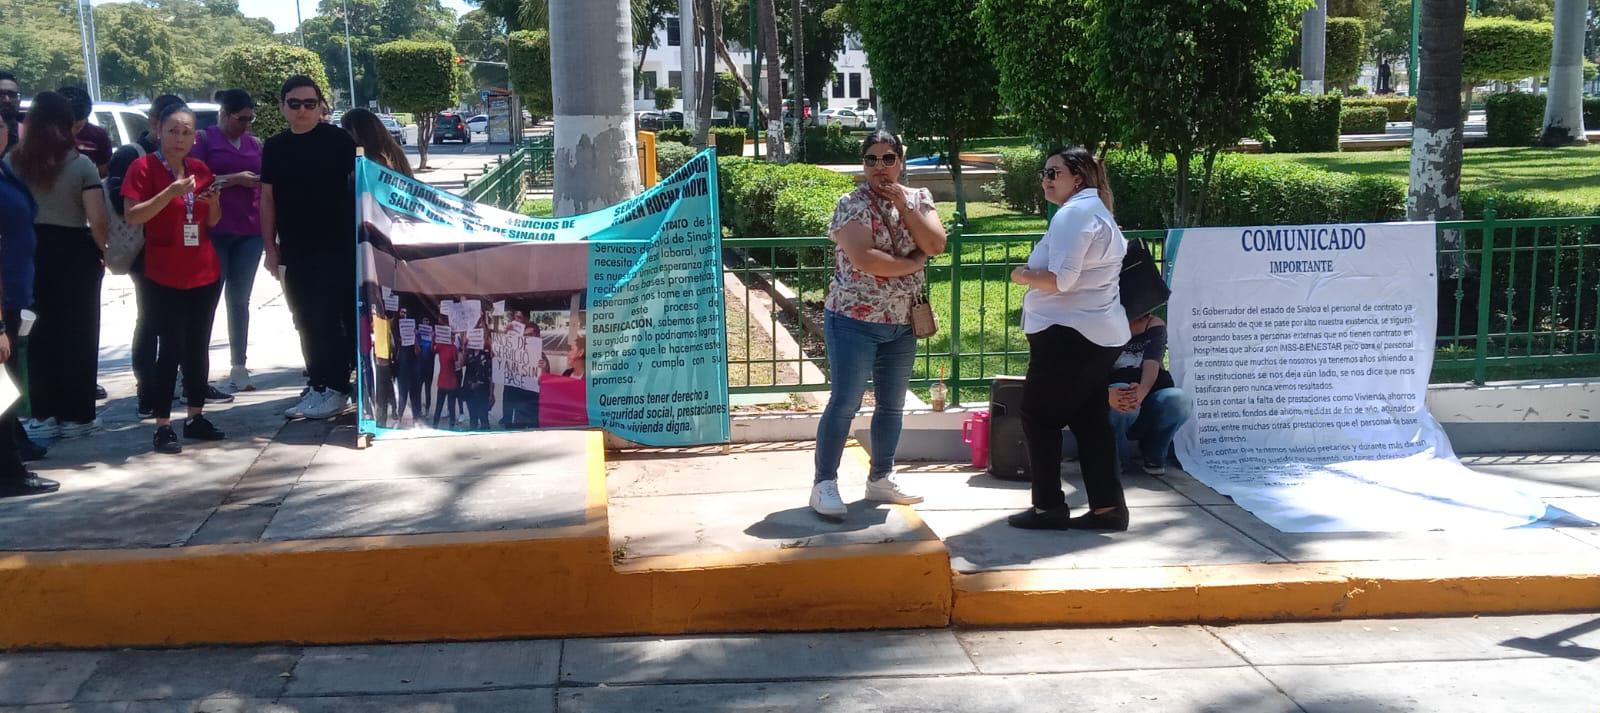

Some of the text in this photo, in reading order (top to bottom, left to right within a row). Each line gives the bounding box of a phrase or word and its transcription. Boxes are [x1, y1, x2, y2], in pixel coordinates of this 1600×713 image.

[645, 178, 708, 215] ROCHA MOYA
[562, 219, 575, 229] DE
[693, 217, 705, 227] de
[508, 229, 556, 241] SINALOA
[1241, 228, 1366, 251] COMUNICADO
[594, 234, 684, 254] Servicios de
[594, 257, 633, 267] necesita
[661, 247, 697, 259] laboral,
[594, 273, 602, 281] es
[660, 260, 702, 274] esperanza
[1270, 260, 1333, 273] IMPORTANTE
[627, 282, 639, 292] las
[641, 277, 665, 289] bases
[593, 295, 639, 309] esperamos
[657, 289, 681, 299] tome
[683, 289, 694, 297] en
[592, 297, 720, 323] para este proceso de
[1247, 305, 1258, 315] del
[1261, 305, 1284, 314] estado
[1286, 305, 1295, 314] de
[1323, 303, 1330, 313] el
[1331, 303, 1361, 315] personal
[1363, 303, 1372, 312] de
[1374, 302, 1403, 312] contrato
[1403, 304, 1413, 313] ya
[658, 316, 694, 328] sabemos
[1238, 320, 1248, 328] de
[1249, 320, 1262, 331] que
[1264, 320, 1273, 329] se
[1291, 319, 1303, 330] por
[1380, 317, 1389, 325] se
[1390, 314, 1413, 326] siguen
[592, 338, 602, 347] su
[632, 334, 643, 343] no
[645, 331, 653, 341] lo
[1192, 333, 1230, 343] otorgando
[1232, 333, 1252, 341] bases
[1323, 331, 1337, 341] que
[1373, 328, 1402, 338] contrato
[1403, 329, 1414, 337] en
[592, 350, 602, 359] es
[604, 348, 620, 360] por
[622, 348, 637, 357] eso
[639, 347, 656, 358] que
[658, 344, 667, 354] le
[669, 342, 703, 354] hacemos
[1229, 347, 1242, 355] que
[1265, 344, 1278, 353] son
[1384, 340, 1414, 351] personal
[638, 361, 644, 372] y
[651, 358, 685, 371] cumpla
[692, 356, 705, 365] con
[711, 355, 722, 364] su
[1194, 359, 1203, 368] de
[1205, 358, 1233, 368] contrato
[1235, 358, 1249, 369] que
[1250, 356, 1277, 366] muchos
[1278, 357, 1288, 366] de
[1319, 357, 1327, 367] ya
[1328, 355, 1358, 365] tenemos
[1195, 372, 1205, 381] las
[1258, 371, 1267, 380] se
[1269, 371, 1284, 379] nos
[1340, 369, 1349, 377] se
[1350, 368, 1365, 378] nos
[1366, 367, 1383, 377] dice
[1384, 368, 1398, 378] que
[1399, 367, 1415, 376] nos
[592, 376, 637, 388] promesa.
[1233, 383, 1297, 395] pero nunca vemos
[599, 389, 709, 407] Queremos tener derecho a
[1210, 397, 1221, 406] sin
[1222, 396, 1246, 406] contar
[1248, 395, 1255, 405] la
[1256, 394, 1274, 404] falta
[1275, 394, 1286, 404] de
[1332, 393, 1354, 402] como
[646, 405, 675, 419] social,
[676, 401, 727, 419] prestaciones
[1213, 409, 1220, 419] el
[1268, 408, 1278, 417] de
[1333, 405, 1342, 414] de
[1354, 404, 1364, 413] de
[601, 418, 608, 427] y
[627, 420, 665, 433] vivienda
[665, 420, 692, 434] digna.
[1221, 423, 1241, 432] entre
[1242, 421, 1270, 432] muchas
[1271, 421, 1291, 430] otras
[1336, 420, 1350, 430] que
[1351, 418, 1359, 427] el
[1360, 417, 1392, 428] personal
[1401, 416, 1418, 425] base
[1352, 443, 1358, 453] y
